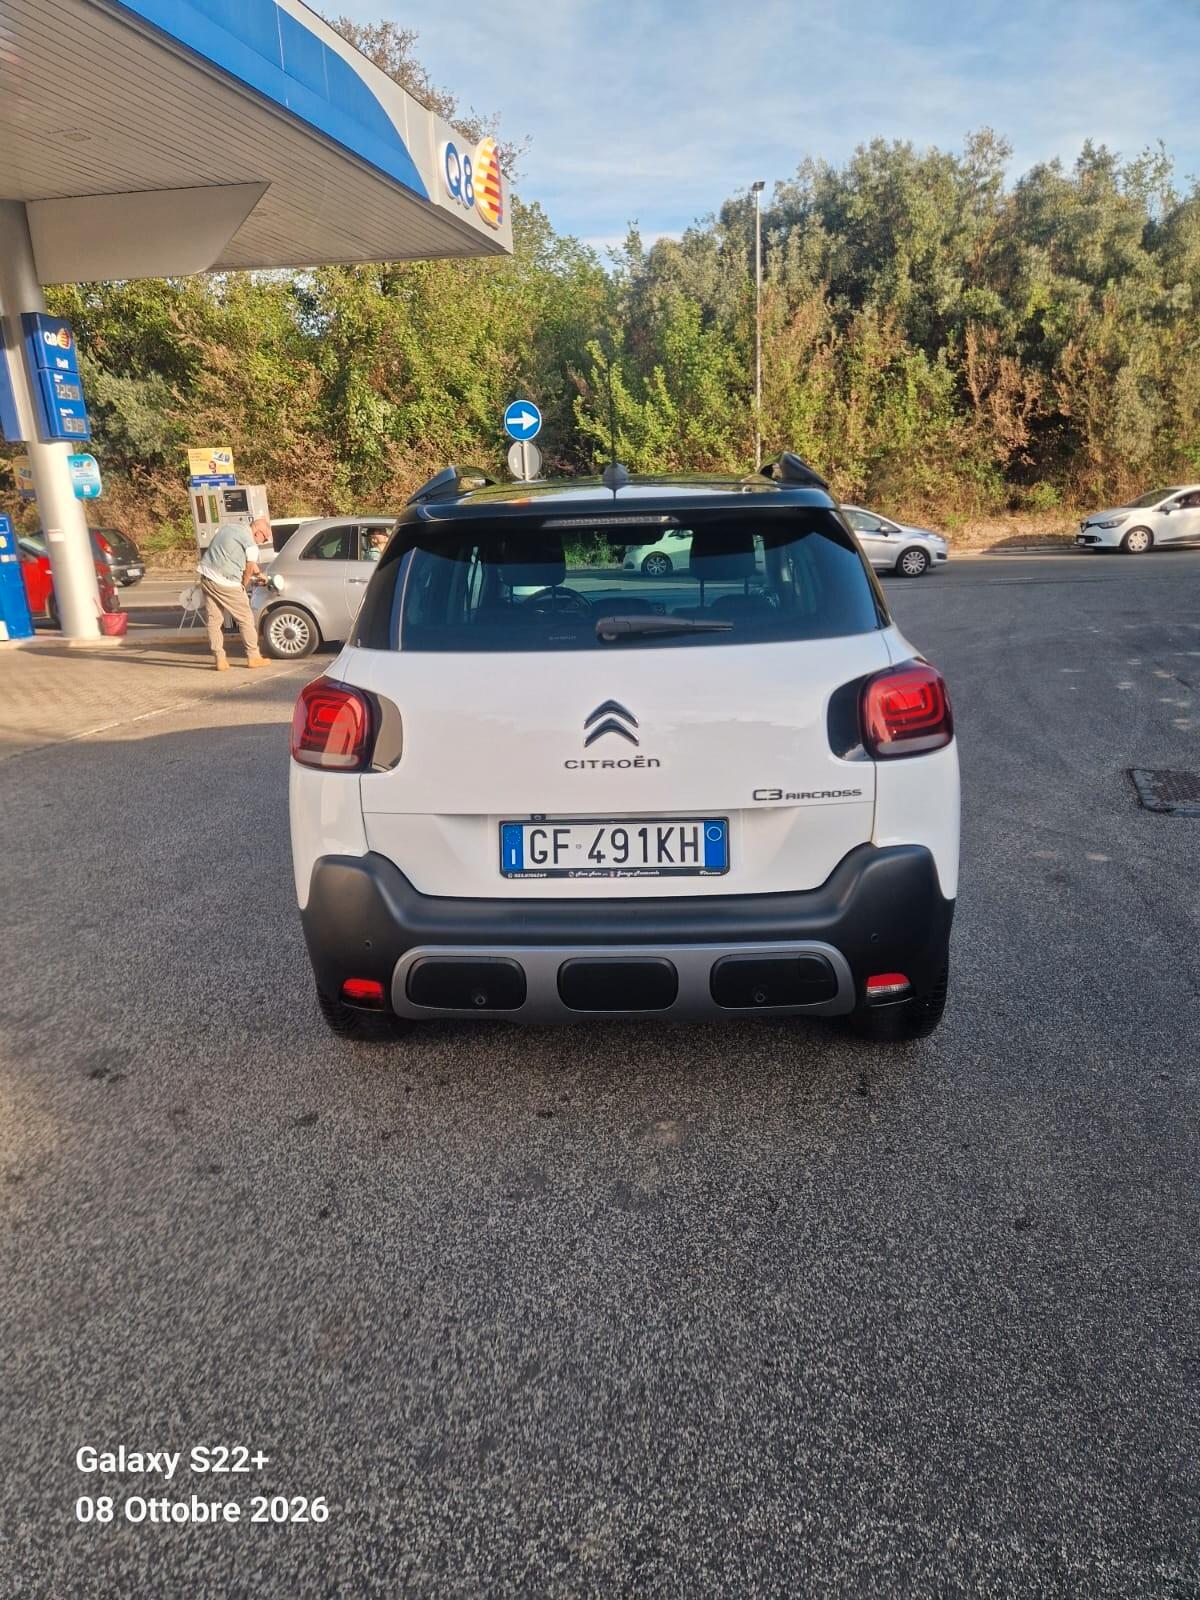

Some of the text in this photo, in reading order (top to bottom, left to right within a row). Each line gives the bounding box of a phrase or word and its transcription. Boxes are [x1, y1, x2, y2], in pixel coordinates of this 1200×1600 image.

[444, 142, 475, 207] Q8
[752, 788, 863, 801] C3 AIRCROSS
[529, 826, 699, 865] GF 491KH
